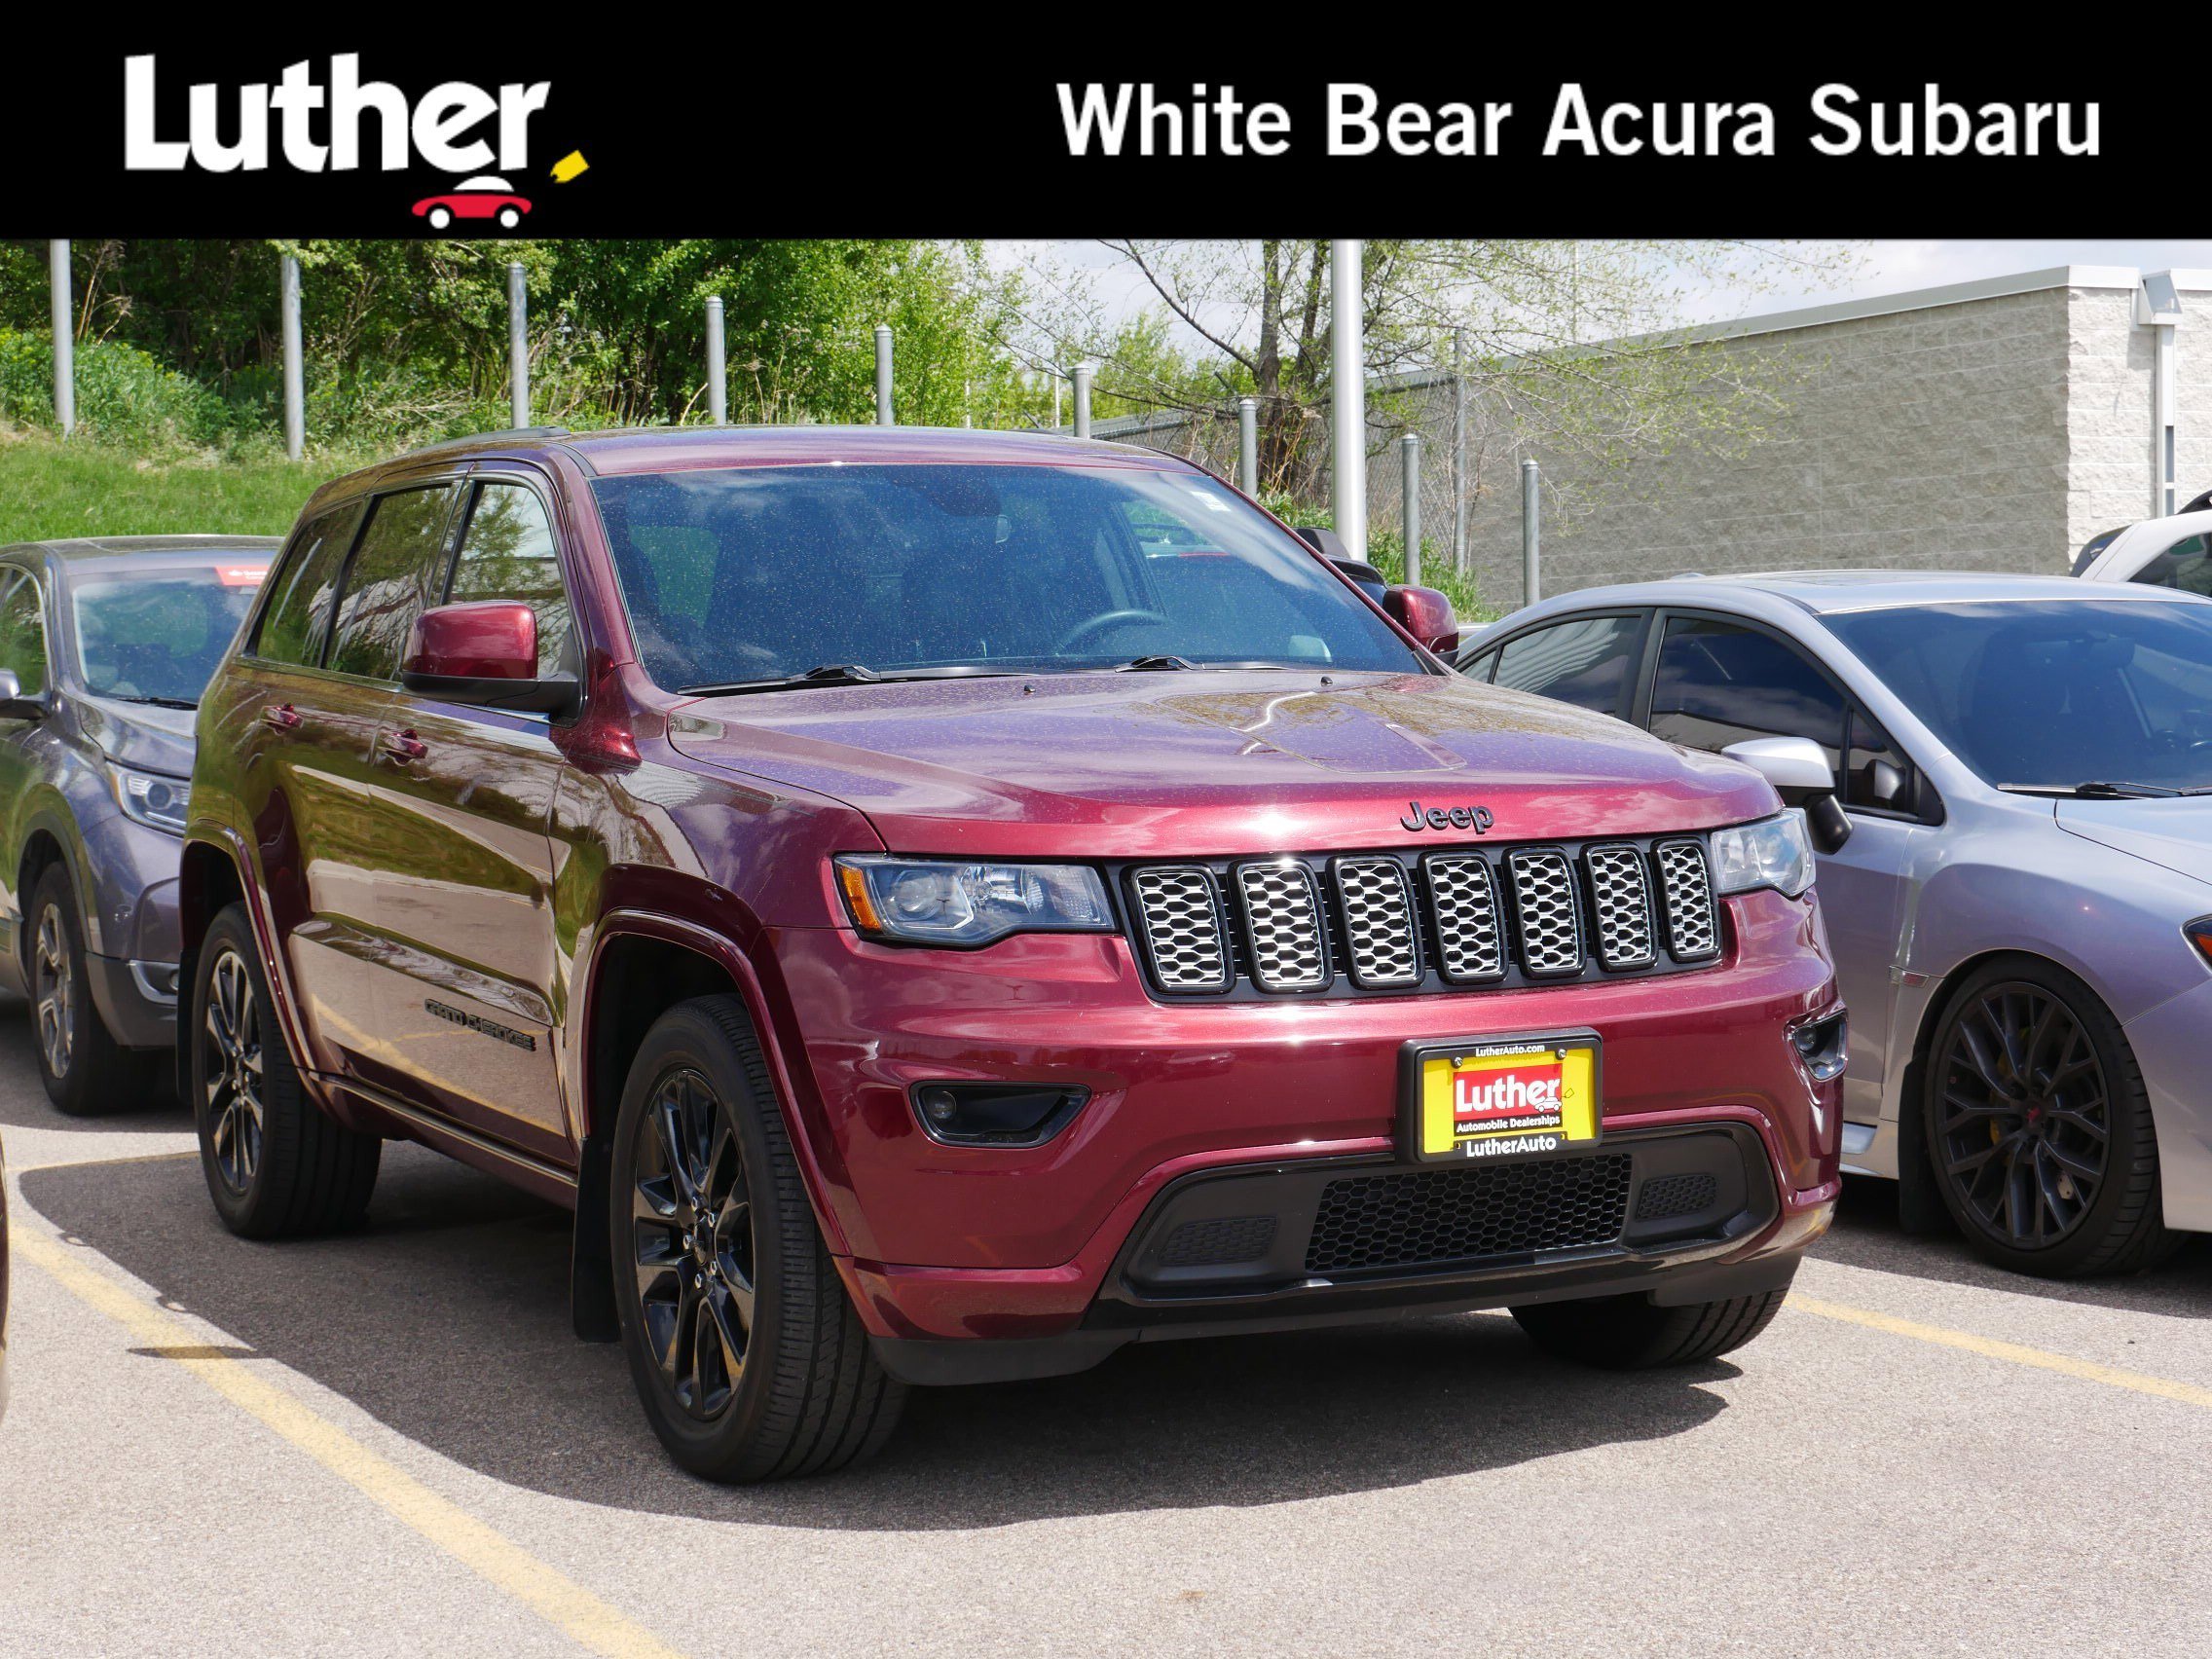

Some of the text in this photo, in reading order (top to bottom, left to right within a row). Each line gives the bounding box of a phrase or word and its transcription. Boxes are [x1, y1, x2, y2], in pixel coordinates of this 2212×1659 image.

[1400, 801, 1494, 834] Jeep
[1475, 1045, 1545, 1057] LutherAuto.com
[1456, 1074, 1561, 1112] Luther
[1456, 1115, 1561, 1133] Automobile Dealerships
[1466, 1135, 1557, 1158] LutherAuto
